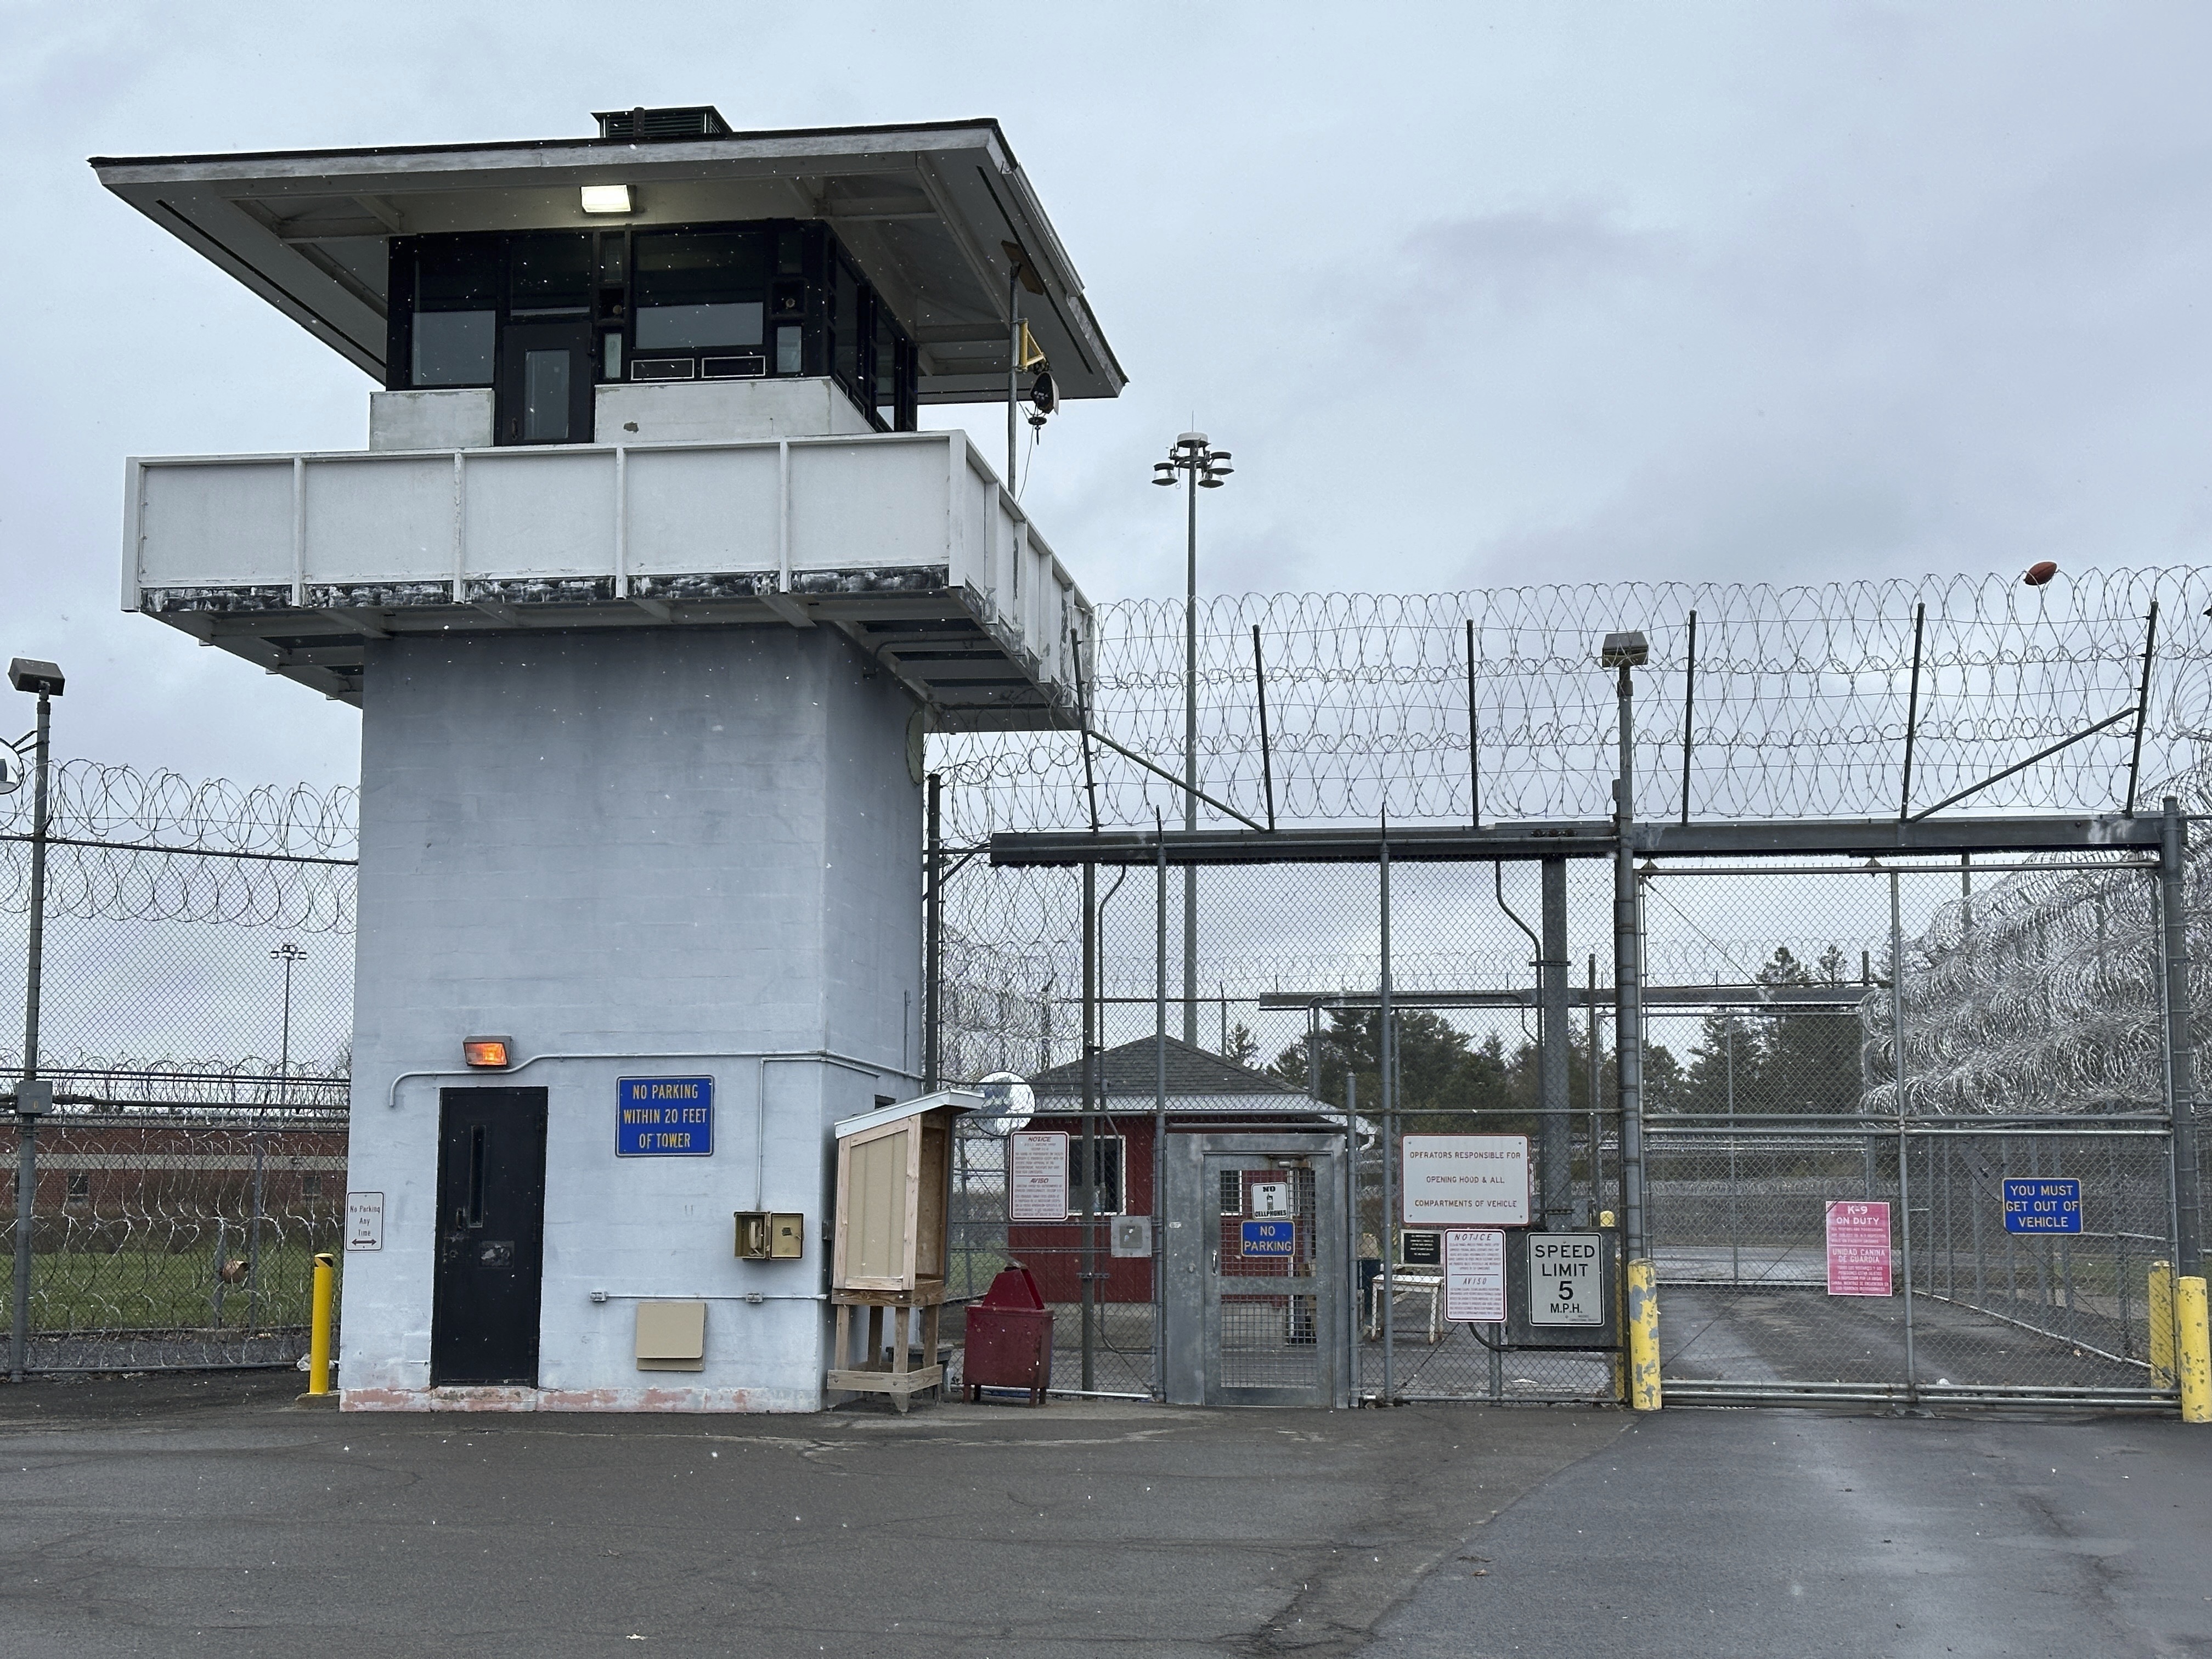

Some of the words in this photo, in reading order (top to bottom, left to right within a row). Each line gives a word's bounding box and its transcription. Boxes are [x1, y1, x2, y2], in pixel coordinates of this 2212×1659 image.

[633, 1085, 647, 1099] NO
[652, 1084, 698, 1099] PARKING
[623, 1109, 659, 1124] WITHIN
[665, 1108, 678, 1123] 20
[682, 1108, 707, 1124] FEET
[639, 1133, 653, 1149] OF
[657, 1133, 691, 1148] TOWER
[2010, 1185, 2035, 1196] YOU
[2041, 1185, 2073, 1196] MUST
[359, 1205, 380, 1214] Parking
[1847, 1205, 1868, 1215] K-9
[2006, 1201, 2028, 1211] GET
[2034, 1200, 2057, 1211] OUT
[2063, 1201, 2079, 1211] OF
[359, 1217, 370, 1226] Any
[1836, 1217, 1850, 1225] ON
[1853, 1217, 1880, 1225] DUTY
[2018, 1216, 2069, 1227] VEHICLE
[1260, 1226, 1276, 1236] NO
[1244, 1241, 1291, 1251] PARKING
[1534, 1244, 1595, 1258] SPEED
[1542, 1263, 1588, 1277] LIMIT
[1558, 1280, 1574, 1301] 5
[1550, 1303, 1583, 1313] M.P.H.
